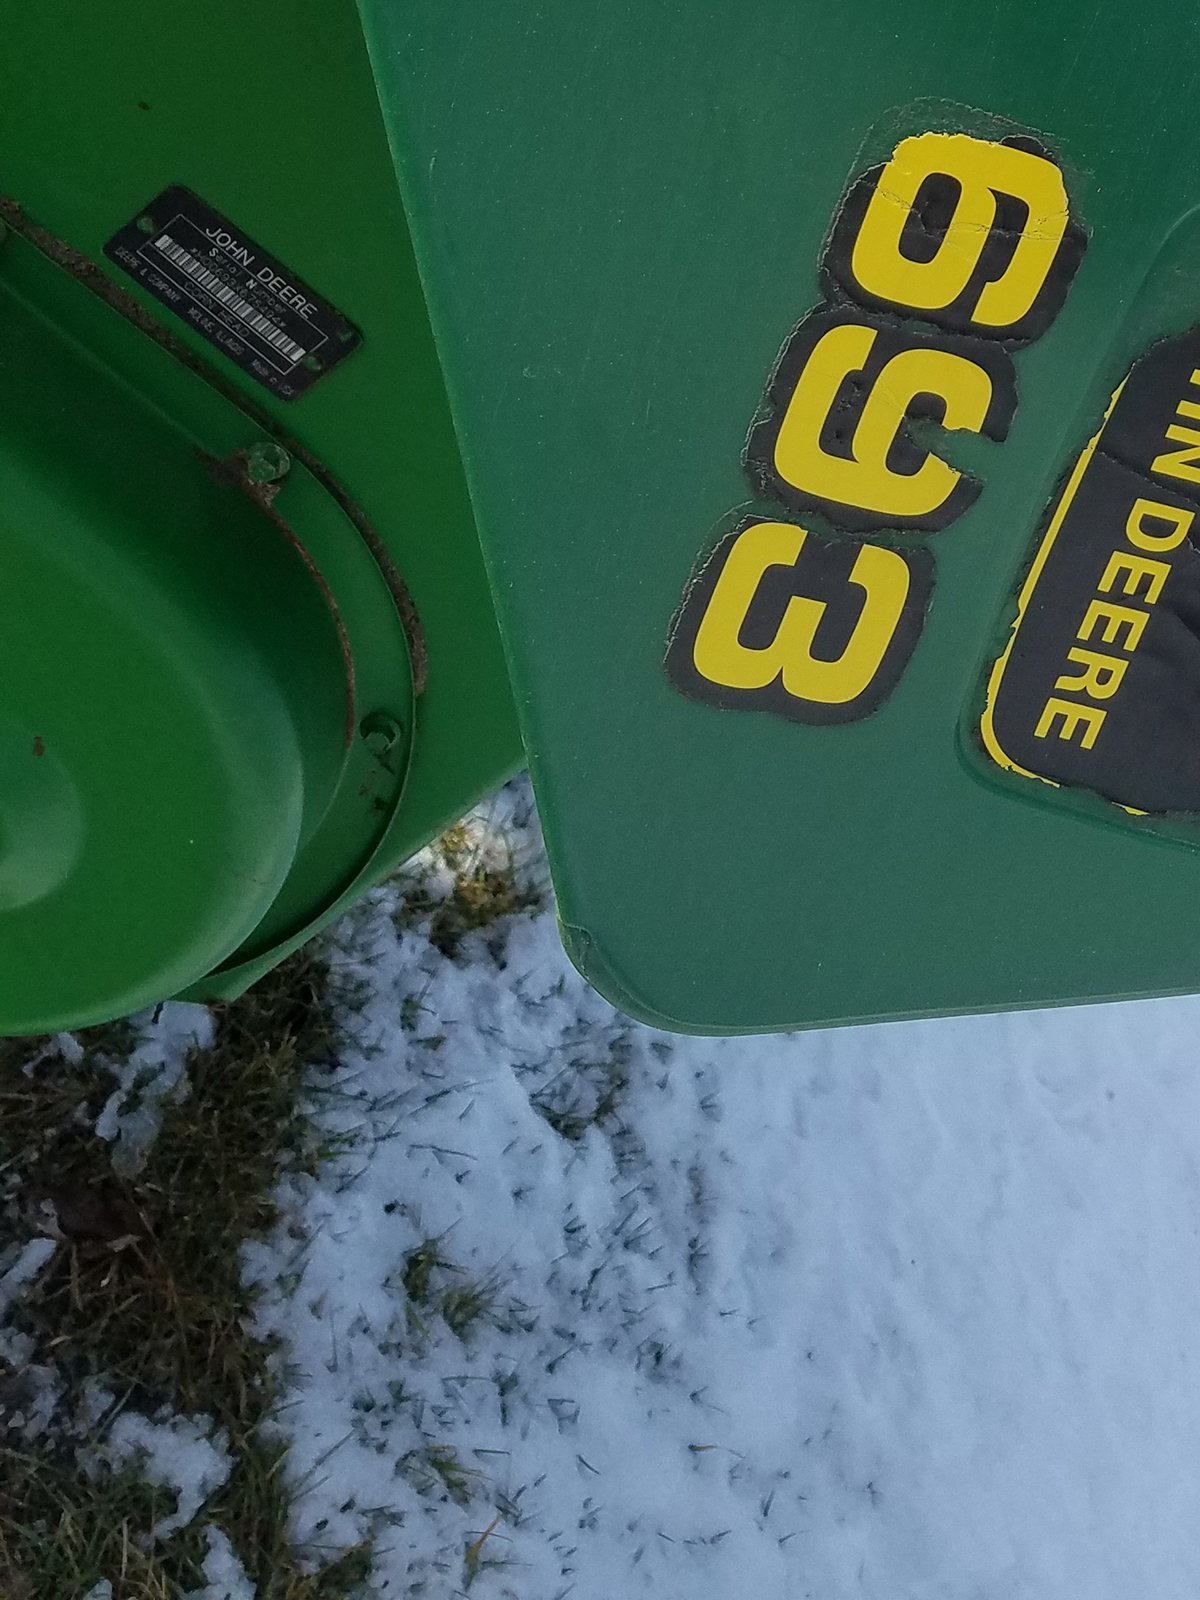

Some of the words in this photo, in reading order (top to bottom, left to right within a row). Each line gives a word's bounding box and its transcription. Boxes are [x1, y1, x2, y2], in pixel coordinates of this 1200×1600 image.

[184, 281, 215, 309] CORN
[218, 309, 251, 337] HEAD
[205, 227, 256, 267] JOHN
[256, 266, 318, 319] DEERE
[208, 247, 241, 278] Serial
[245, 279, 287, 313] Number
[691, 131, 1070, 705] 693
[1033, 497, 1194, 750] DEERE
